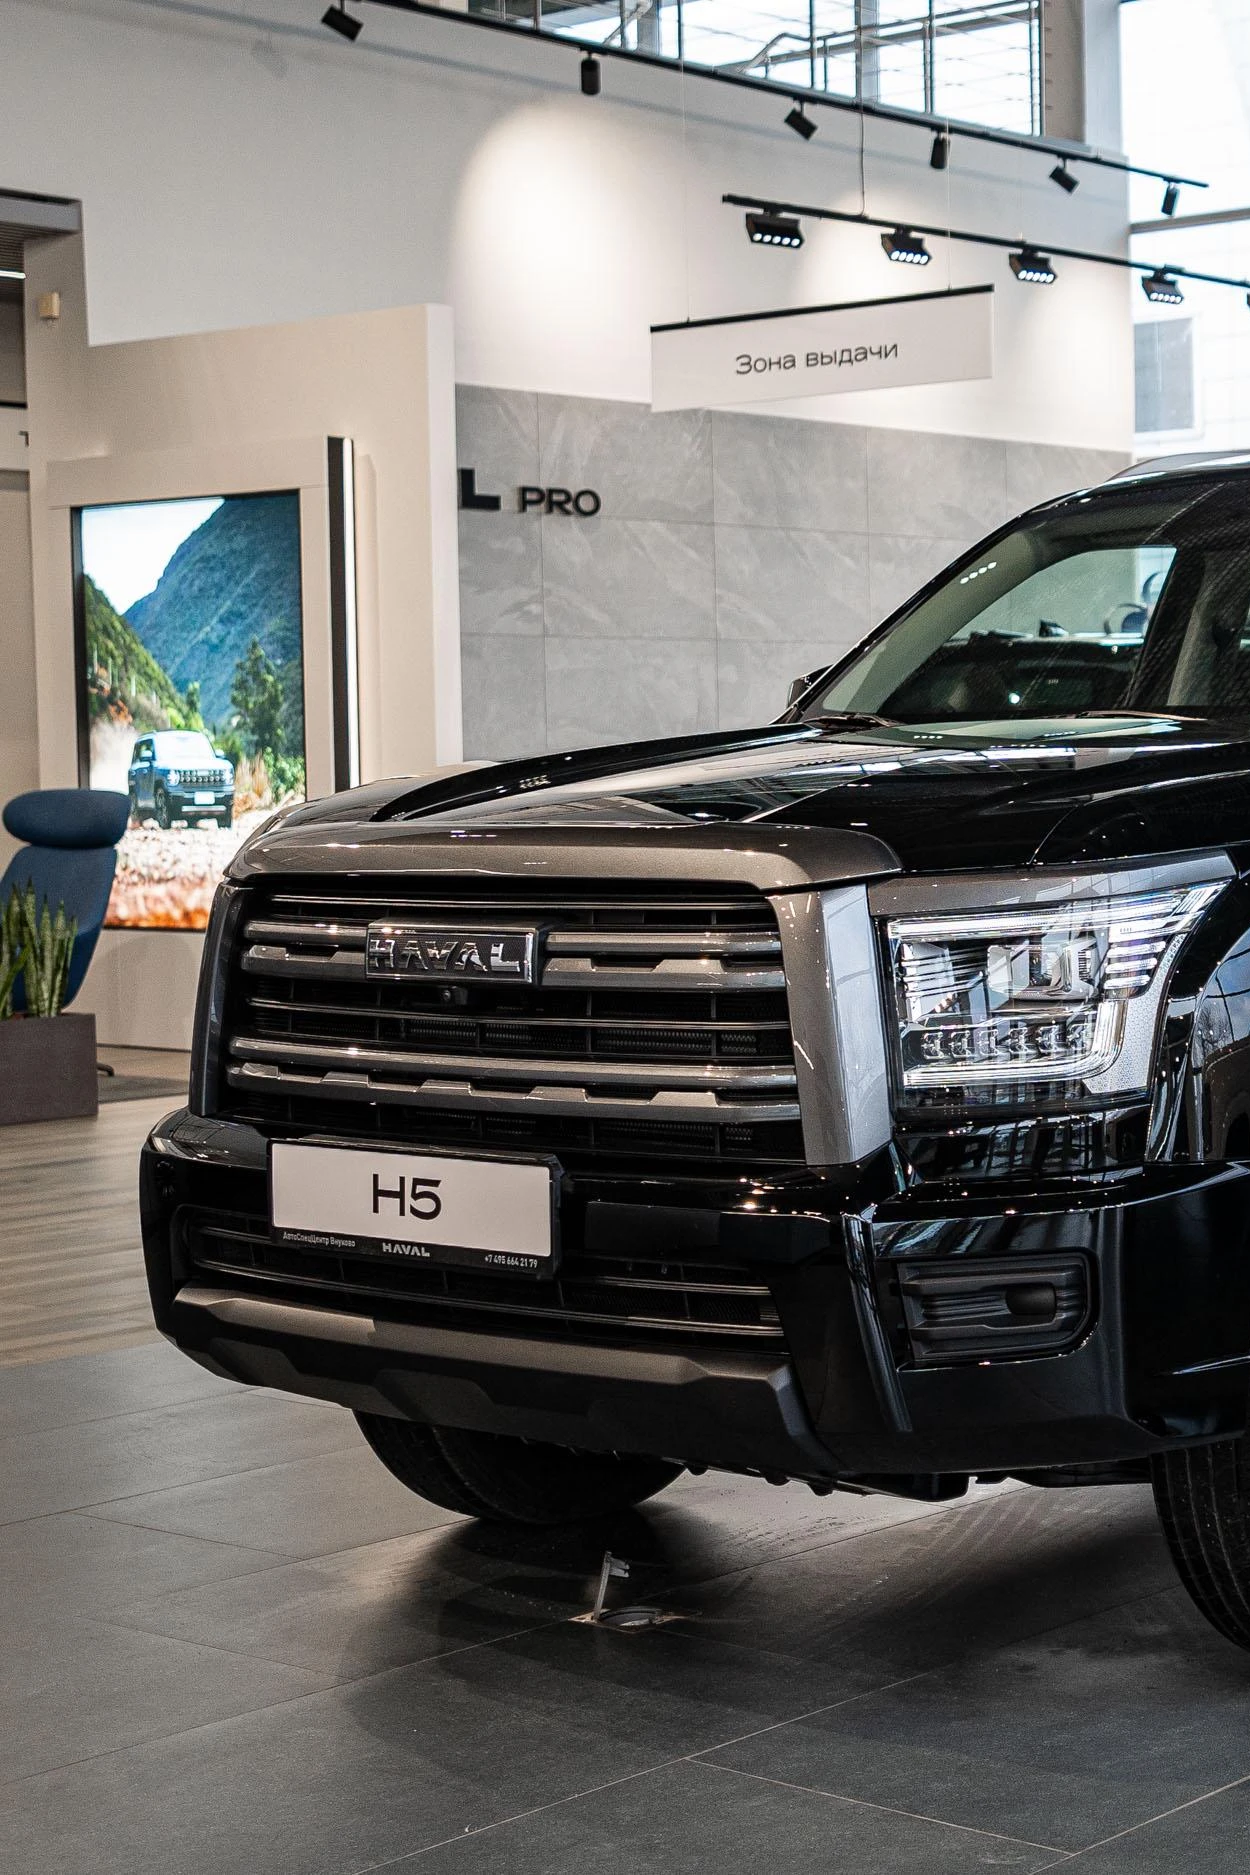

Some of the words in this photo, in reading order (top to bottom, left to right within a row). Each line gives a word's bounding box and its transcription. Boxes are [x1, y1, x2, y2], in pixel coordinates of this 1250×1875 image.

[735, 353, 796, 375] Зона
[805, 343, 899, 368] выдачи
[517, 485, 602, 518] PRO
[368, 939, 521, 973] HAVAL
[372, 1173, 442, 1221] H5
[330, 1236, 356, 1248] Внуково
[381, 1242, 431, 1257] HAVAL
[484, 1254, 493, 1264] +7
[493, 1254, 506, 1265] 495
[506, 1256, 519, 1267] 664
[520, 1257, 528, 1268] 21
[528, 1258, 538, 1269] 79
